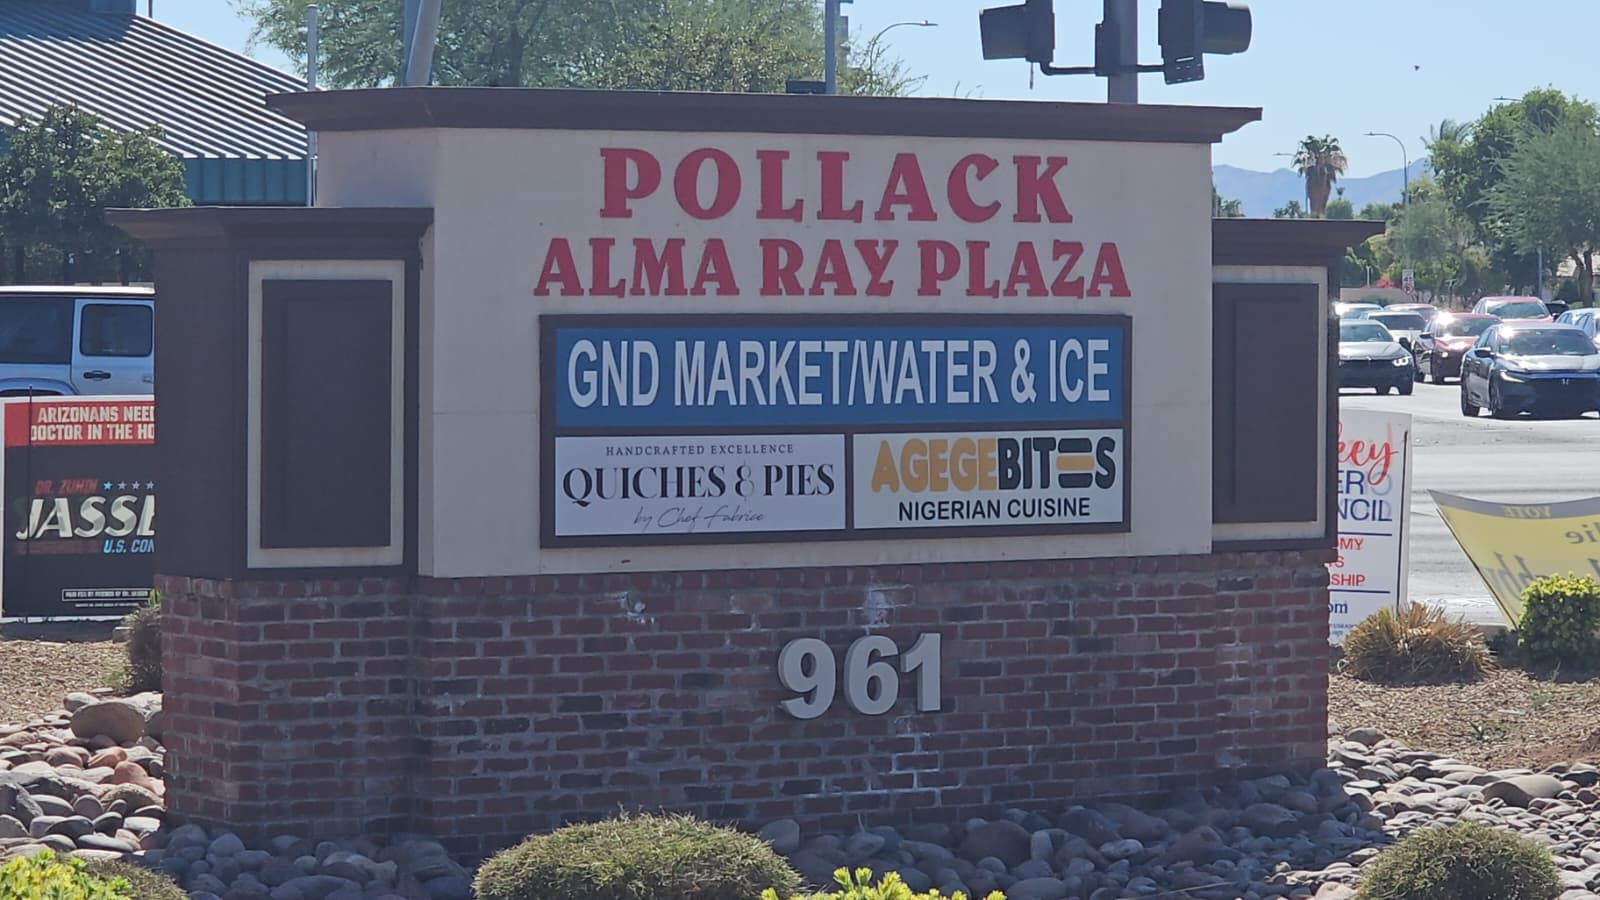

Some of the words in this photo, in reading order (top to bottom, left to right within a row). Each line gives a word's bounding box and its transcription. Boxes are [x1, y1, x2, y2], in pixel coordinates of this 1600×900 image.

[599, 147, 1073, 224] POLLACK
[533, 237, 740, 299] ALMA
[759, 238, 899, 299] RAY
[917, 239, 1132, 300] PLAZA
[567, 339, 660, 408] GND
[674, 339, 999, 407] MARKET/WATER
[1010, 338, 1037, 405] &
[1049, 338, 1110, 403] ICE
[37, 405, 119, 423] ARIZONANS
[31, 422, 83, 441] DOCTOR
[87, 423, 102, 440] IN
[107, 423, 133, 440] THE
[606, 445, 706, 457] HANDCRAFTED
[710, 443, 795, 455] EXCELLENCE
[562, 464, 726, 508] QUICHES
[734, 459, 756, 502] &
[763, 462, 835, 497] PIES
[657, 505, 703, 533] Chef
[899, 501, 1001, 522] NIGERIAN
[1007, 497, 1091, 519] CUISINE
[103, 539, 127, 554] U.S.
[1338, 537, 1364, 551] MY
[777, 632, 941, 720] 961
